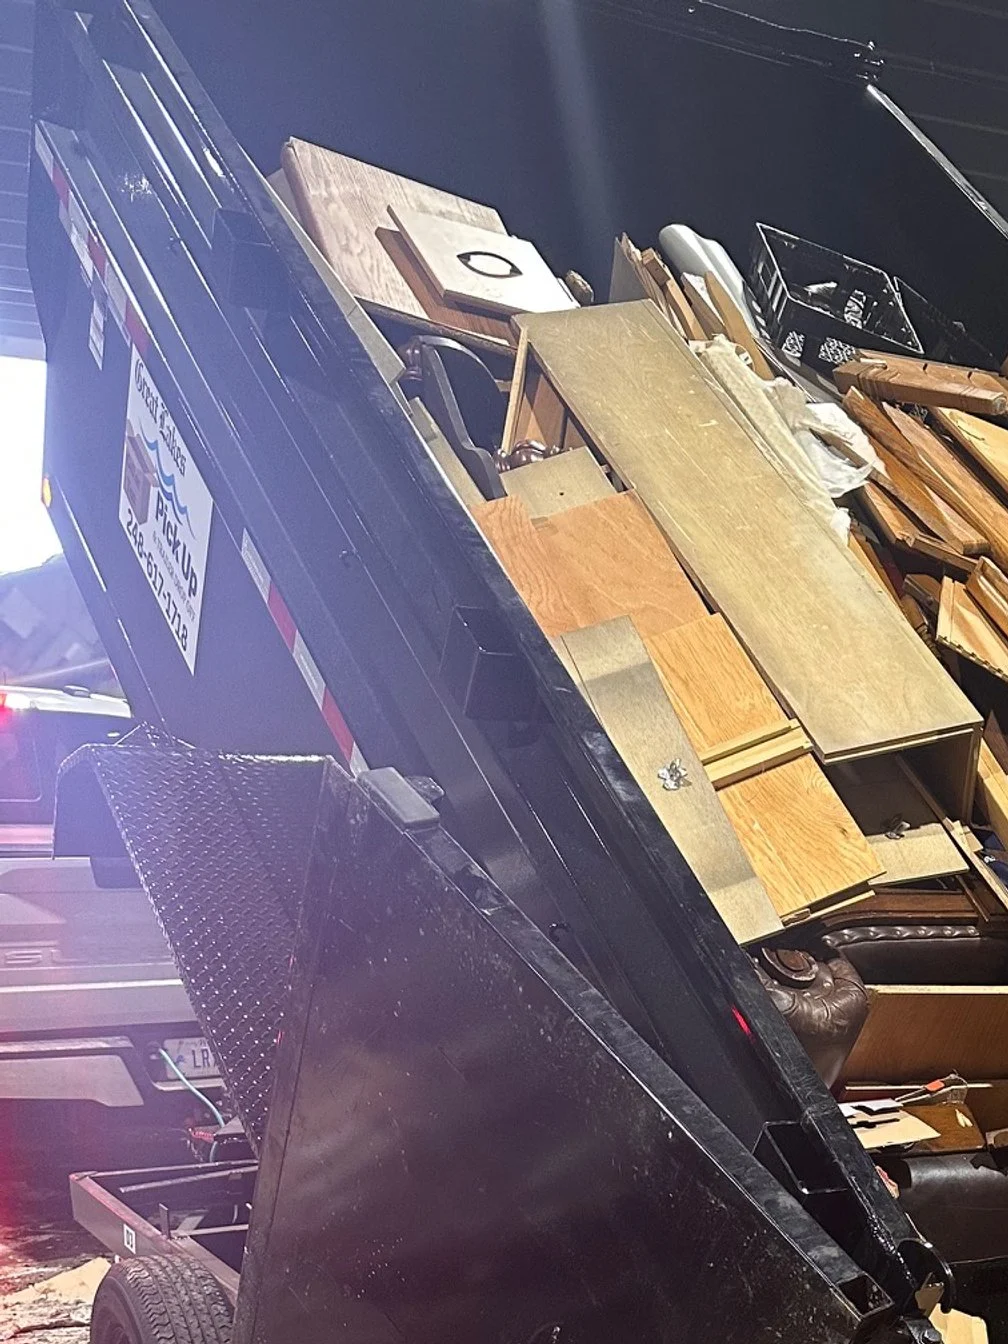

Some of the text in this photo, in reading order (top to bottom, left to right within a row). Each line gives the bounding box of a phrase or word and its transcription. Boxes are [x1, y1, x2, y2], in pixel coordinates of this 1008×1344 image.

[134, 356, 187, 477] Great Lakes
[126, 510, 189, 653] 248-617-1718
[155, 487, 198, 600] Pick Up
[192, 1048, 216, 1068] LR
